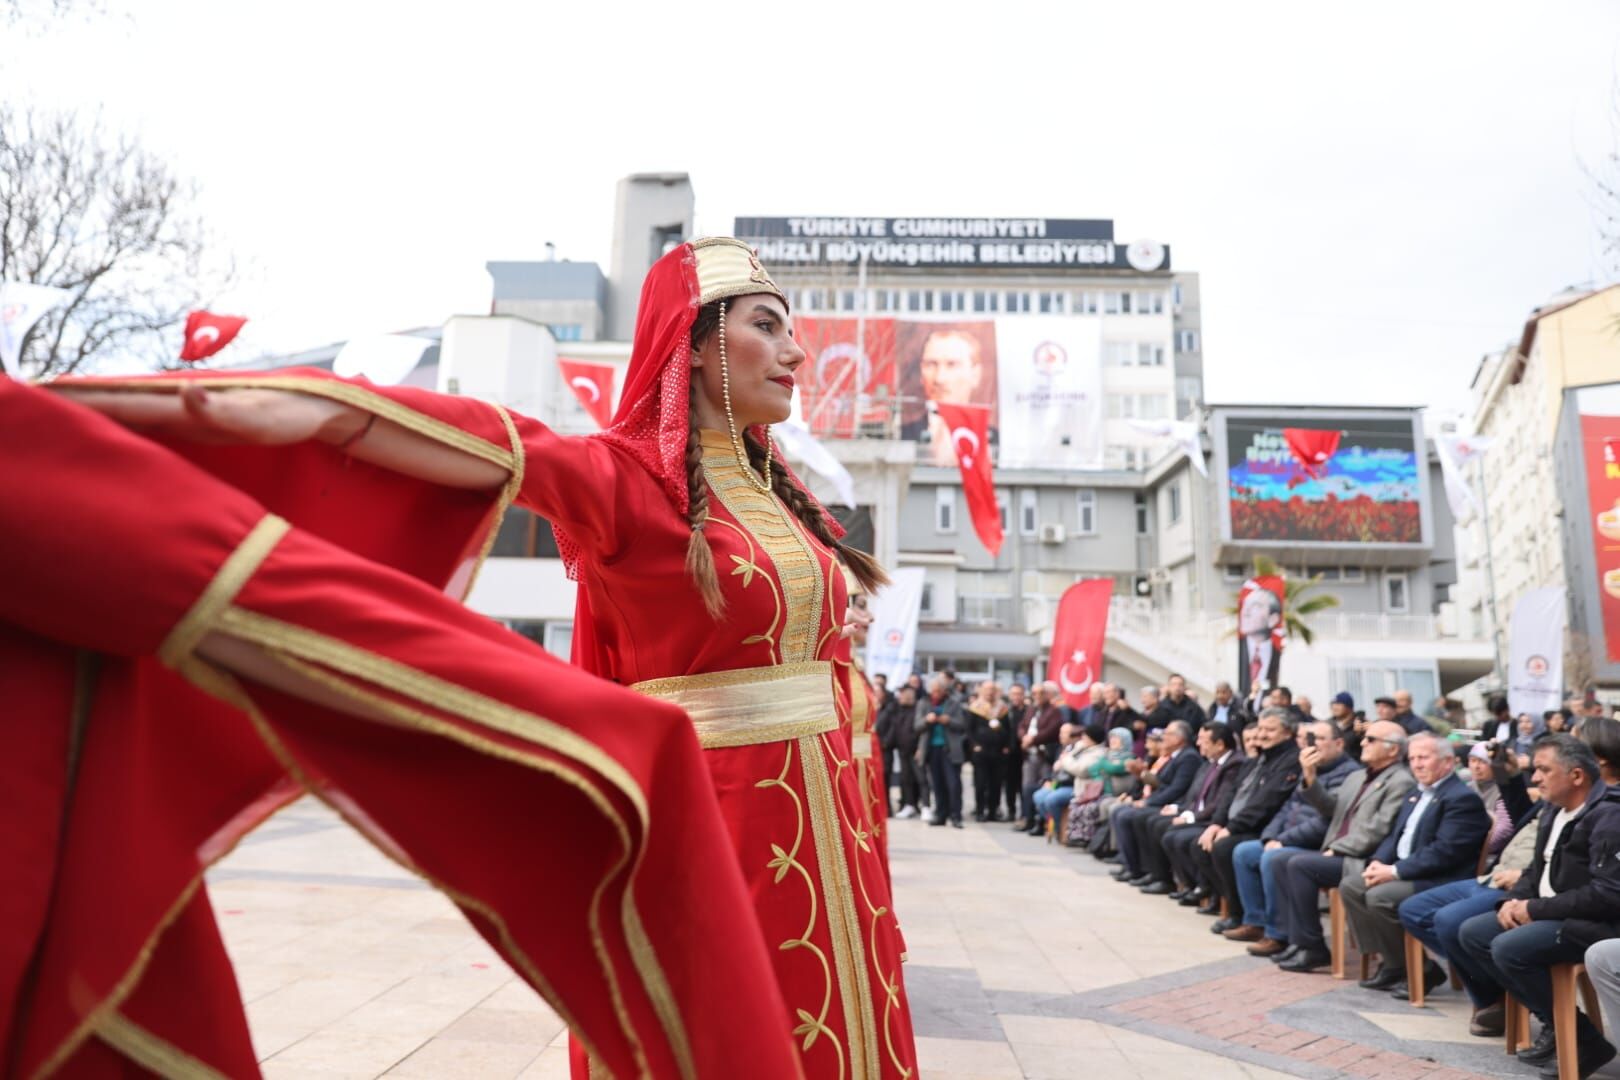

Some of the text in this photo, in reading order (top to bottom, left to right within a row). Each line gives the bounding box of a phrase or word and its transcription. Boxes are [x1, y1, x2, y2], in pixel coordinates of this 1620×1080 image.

[788, 219, 1046, 237] TÜRKİYE CUMHURİYETİ
[826, 240, 976, 264] BÜYÜKŞEHİR
[980, 241, 1115, 263] BELEDİYESİ
